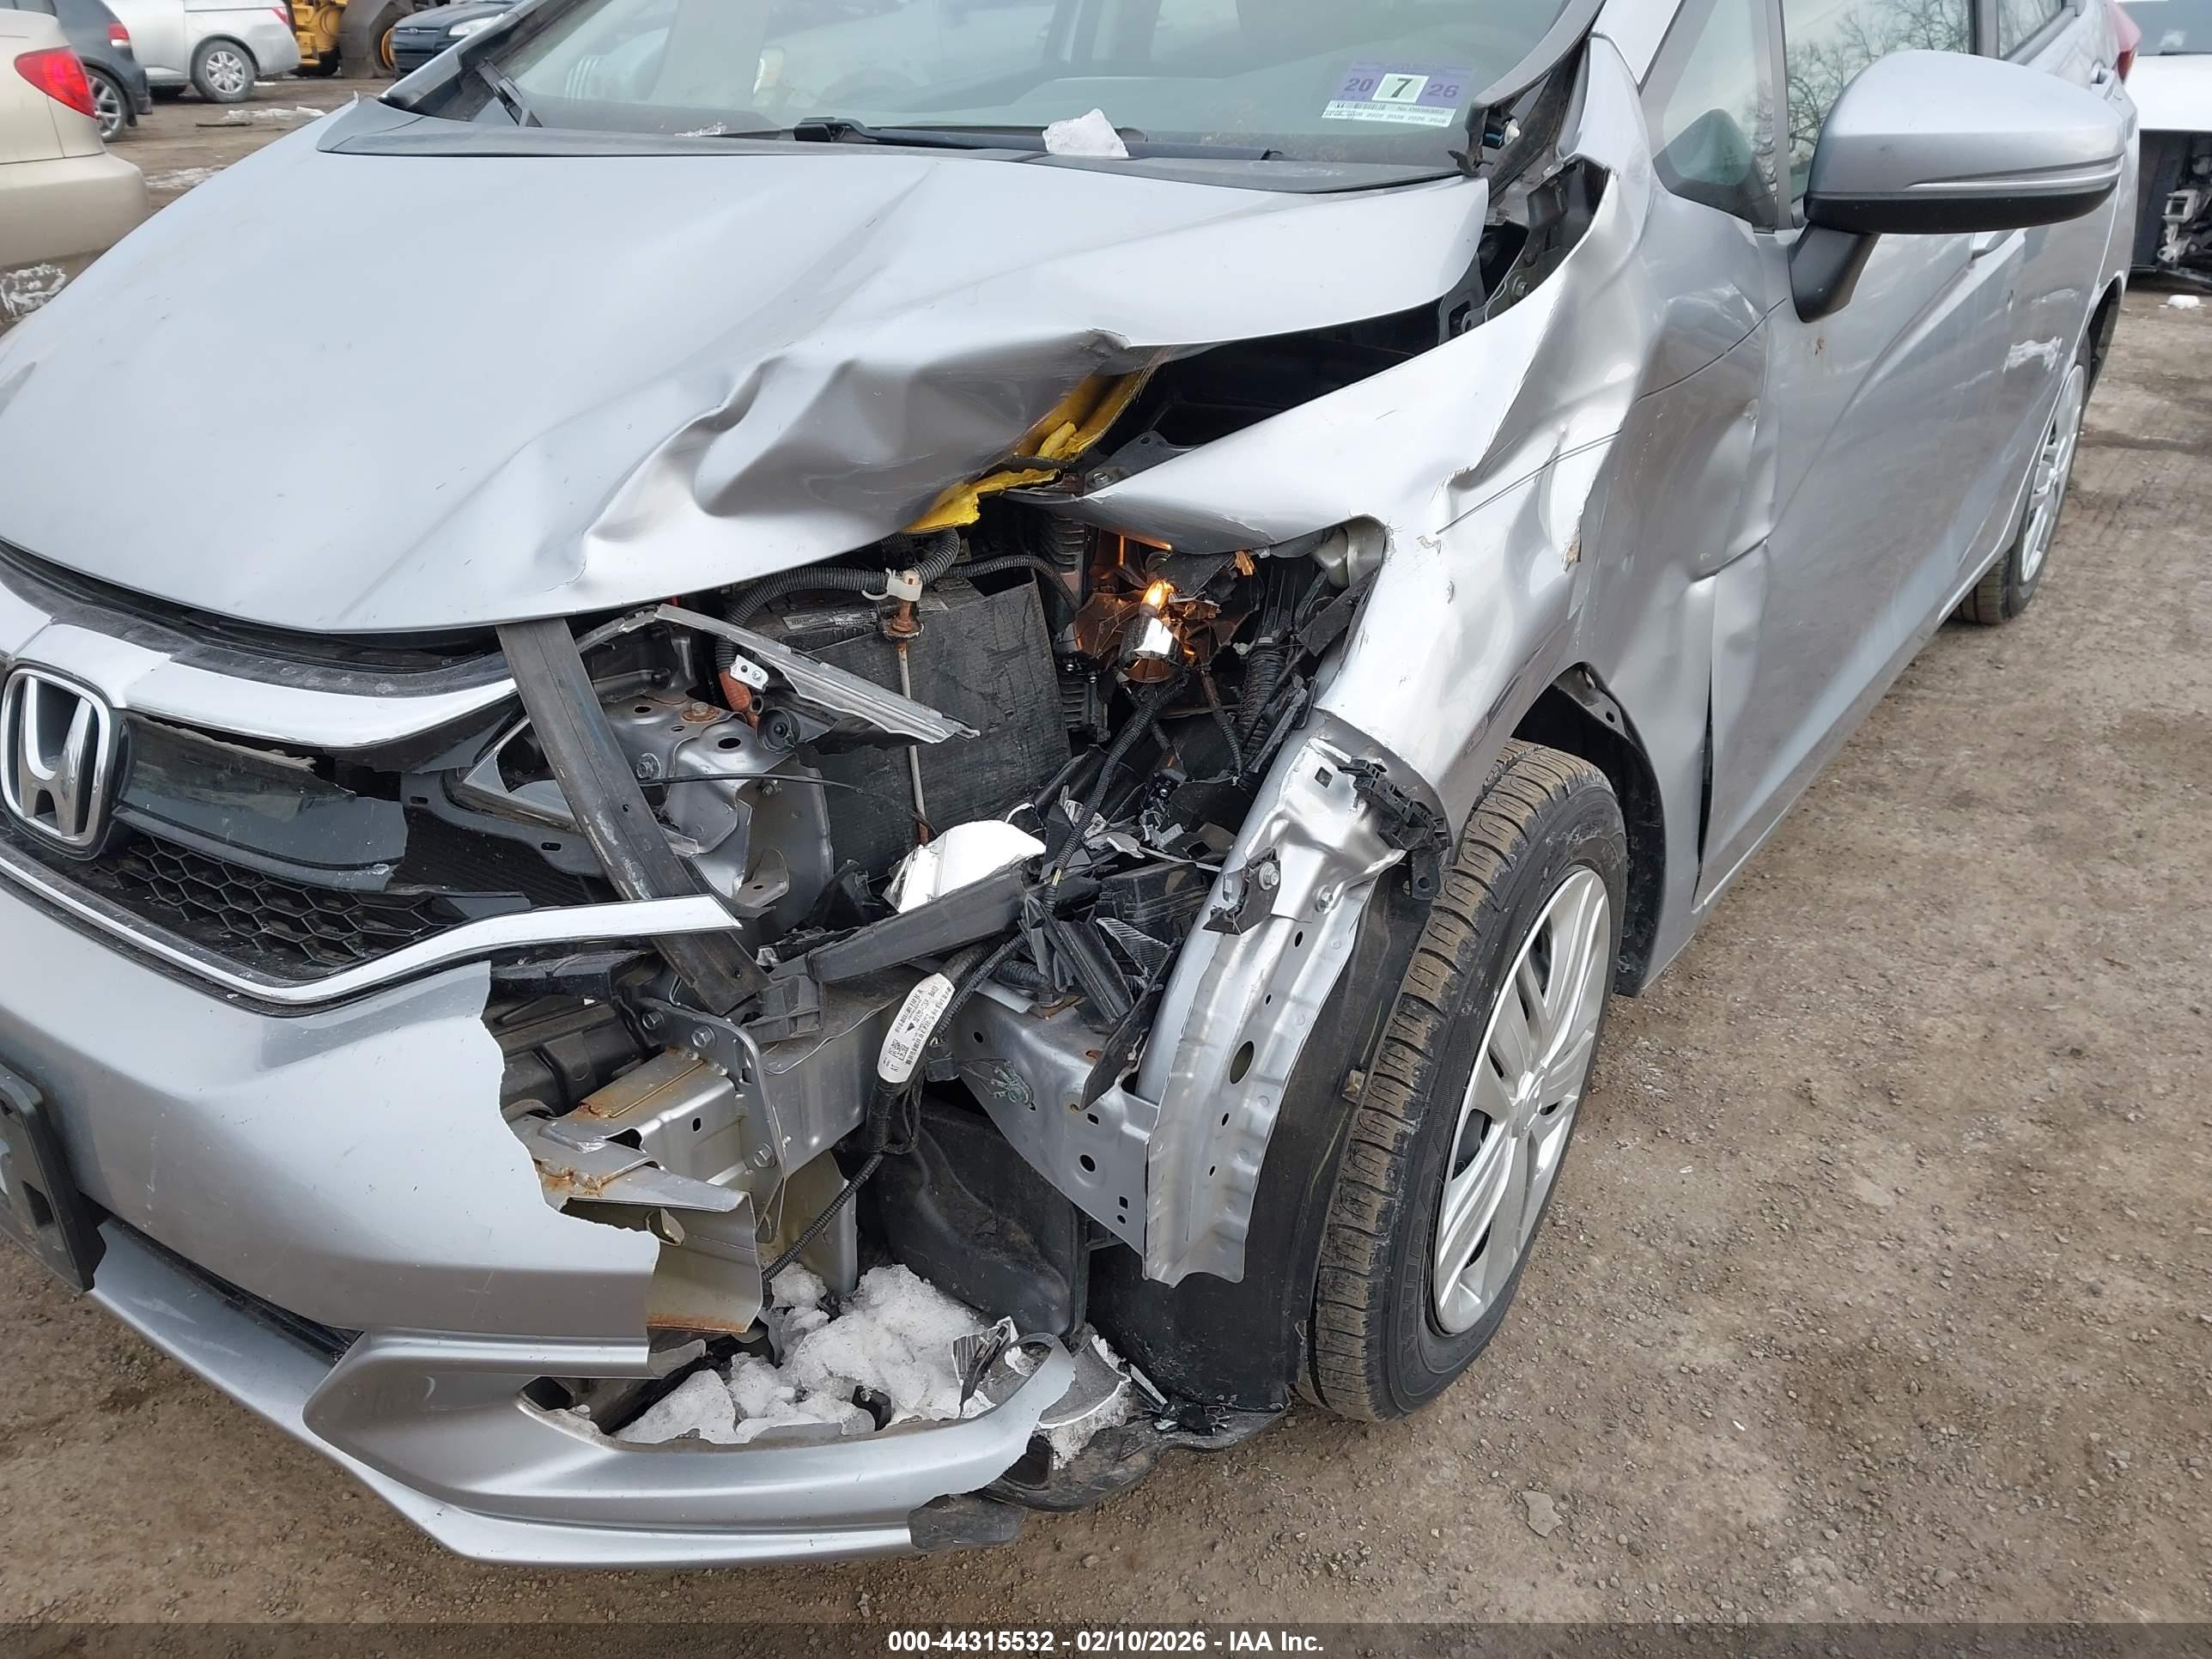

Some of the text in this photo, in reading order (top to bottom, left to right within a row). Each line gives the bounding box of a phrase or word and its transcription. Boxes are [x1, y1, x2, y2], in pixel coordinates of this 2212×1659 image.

[1344, 77, 1460, 98] 20 7 26
